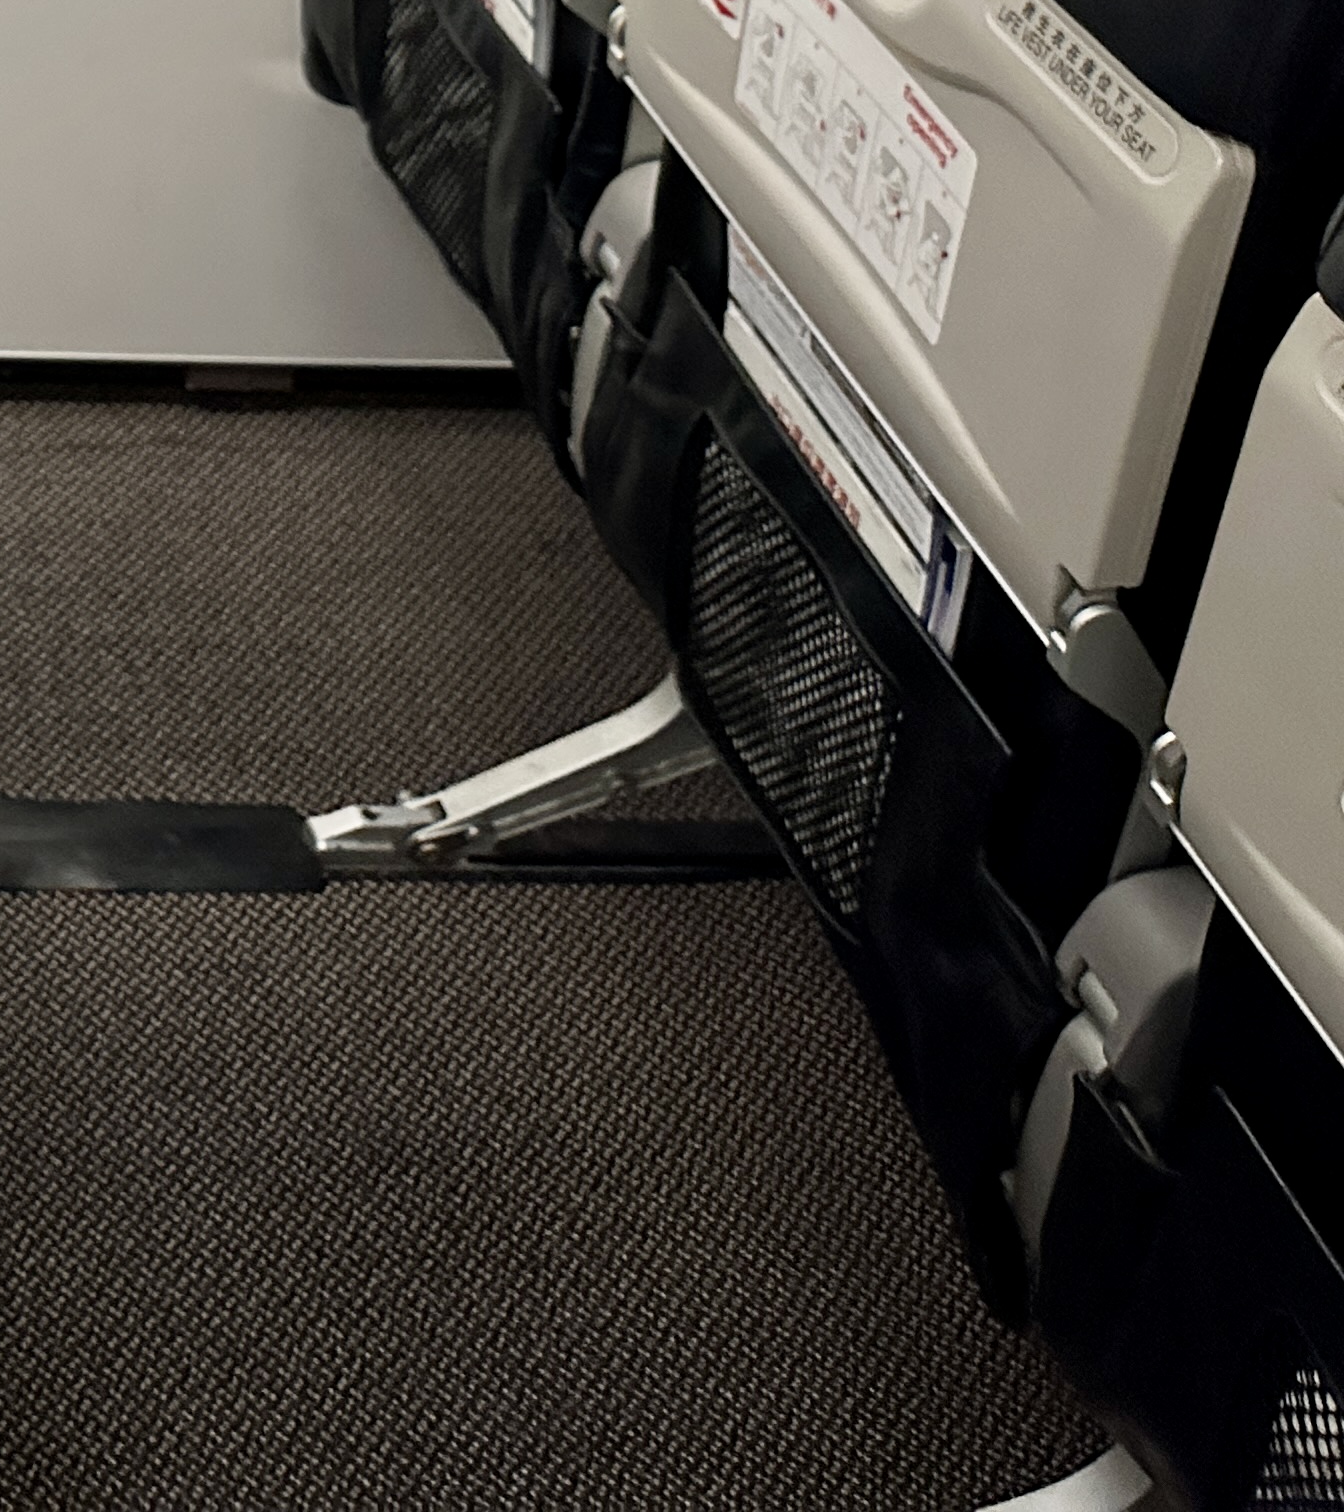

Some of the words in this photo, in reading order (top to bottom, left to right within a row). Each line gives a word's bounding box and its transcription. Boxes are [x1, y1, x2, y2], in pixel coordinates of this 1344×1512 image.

[998, 5, 1022, 34] LIFE
[1022, 26, 1052, 61] VEST
[1048, 56, 1090, 99] UNDER
[1088, 92, 1123, 132] YOUR
[1121, 124, 1156, 162] SEAT
